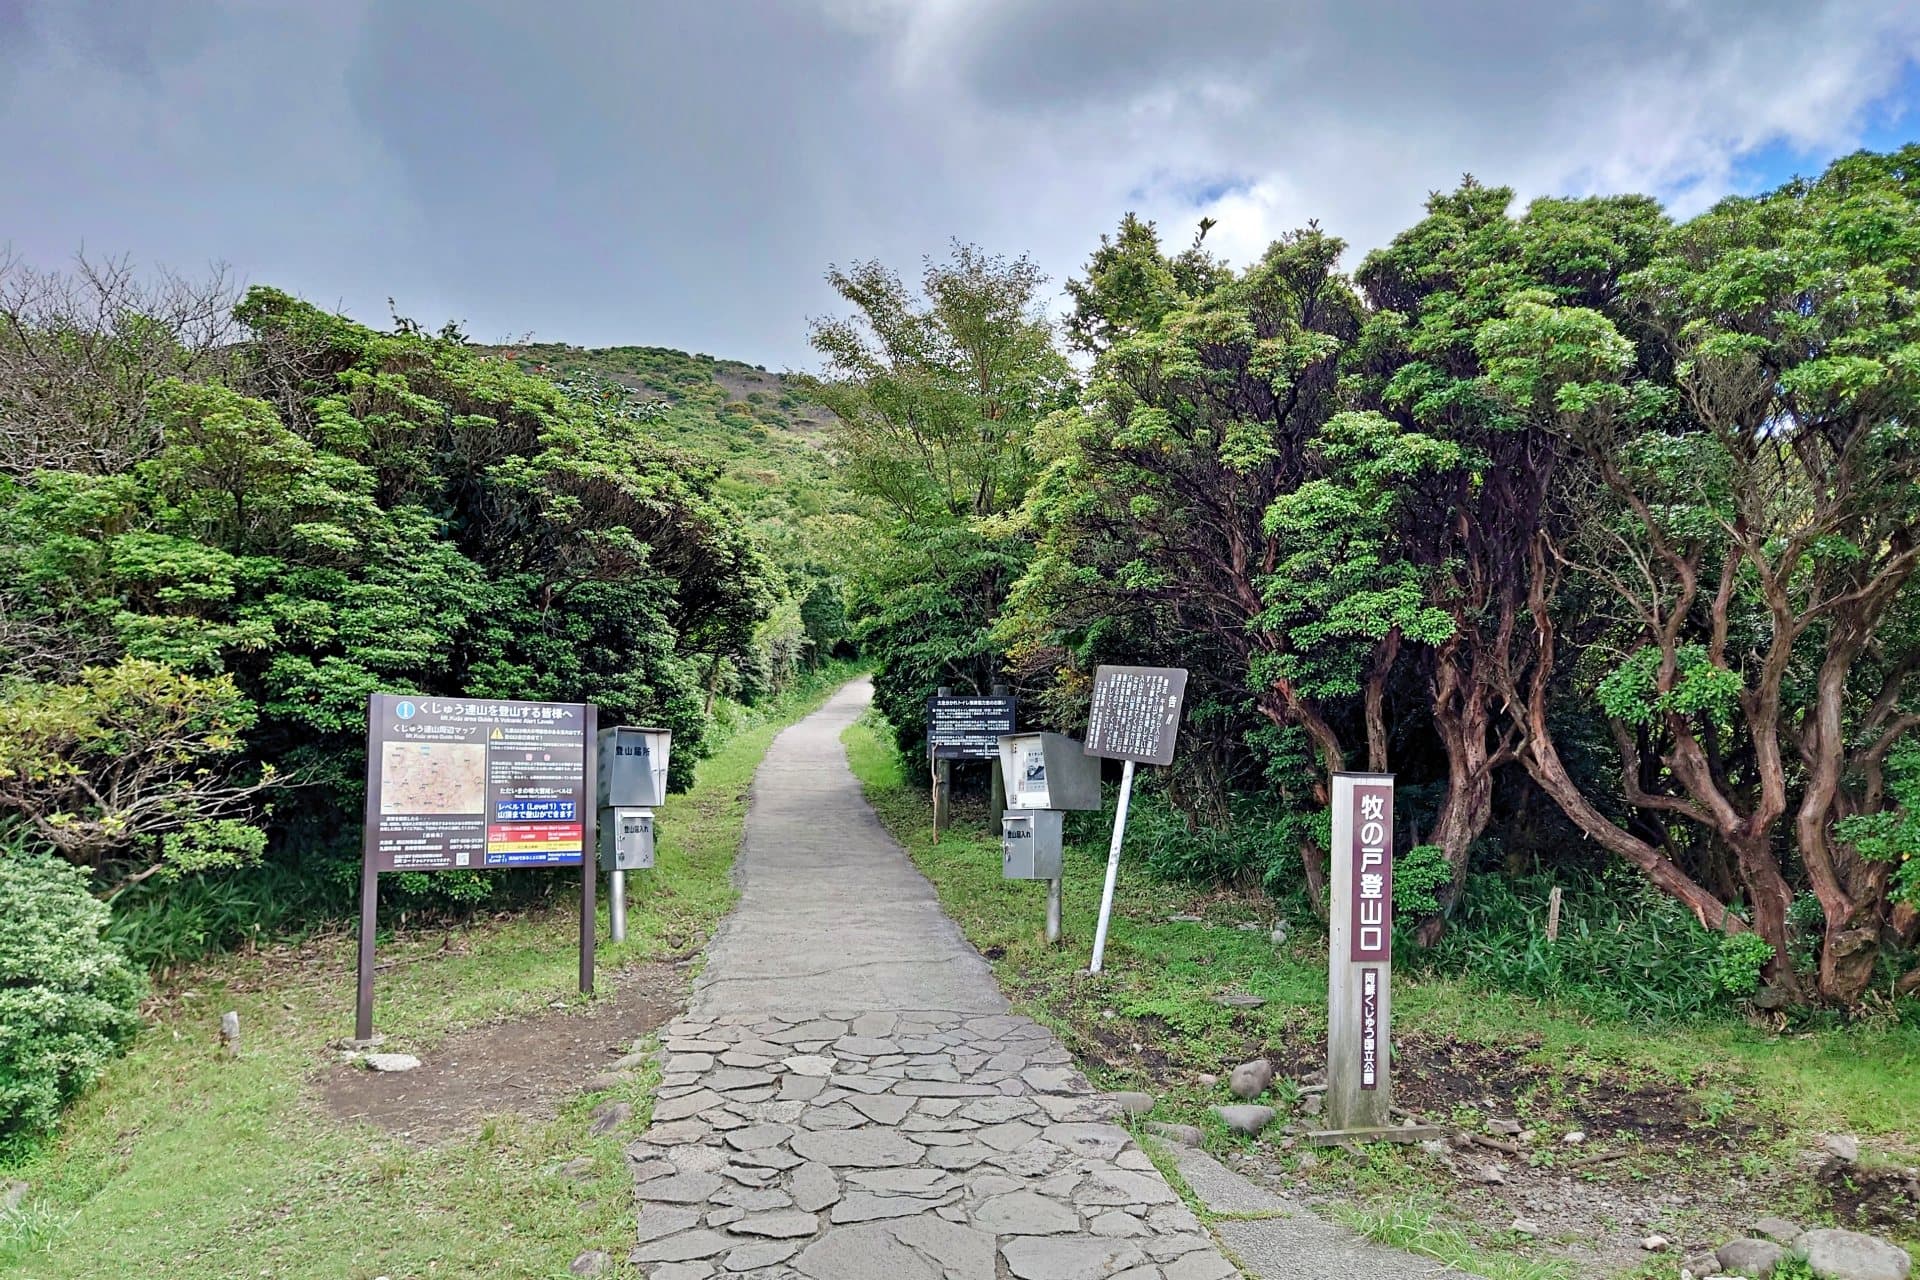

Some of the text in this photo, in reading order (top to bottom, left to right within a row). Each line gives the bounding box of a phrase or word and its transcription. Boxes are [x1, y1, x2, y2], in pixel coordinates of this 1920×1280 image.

[419, 702, 573, 719] くじゅう連山を登山する皆様へ
[1360, 794, 1384, 952] 牧の戸登山口
[1363, 972, 1376, 1086] 阿蘇くじゅう国立公園
